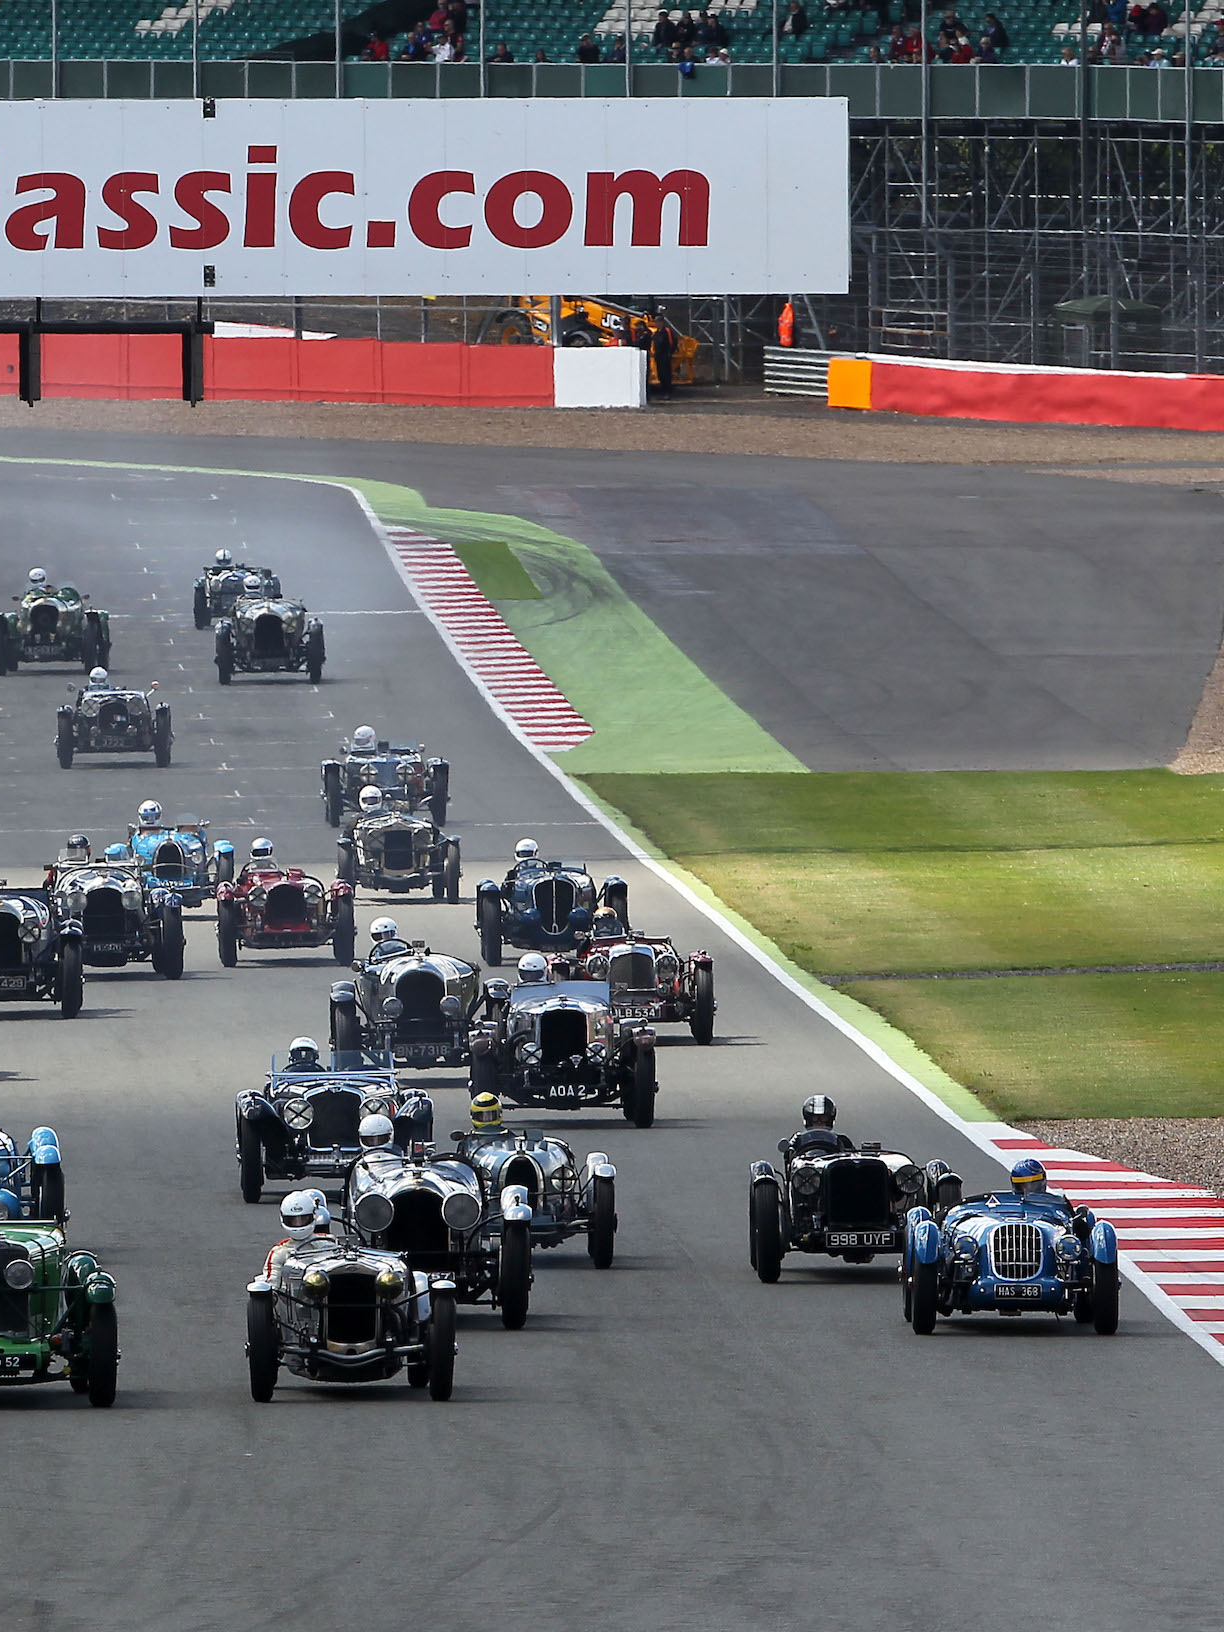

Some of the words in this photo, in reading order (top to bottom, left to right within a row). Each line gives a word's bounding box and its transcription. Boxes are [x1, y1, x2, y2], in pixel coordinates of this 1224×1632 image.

[600, 312, 625, 331] JC
[634, 1007, 656, 1017] 534
[577, 1084, 586, 1096] 2
[830, 1233, 858, 1246] 998
[863, 1233, 891, 1245] UYF
[998, 1286, 1016, 1296] HAS
[1021, 1286, 1039, 1297] 368
[5, 1356, 20, 1368] 52
